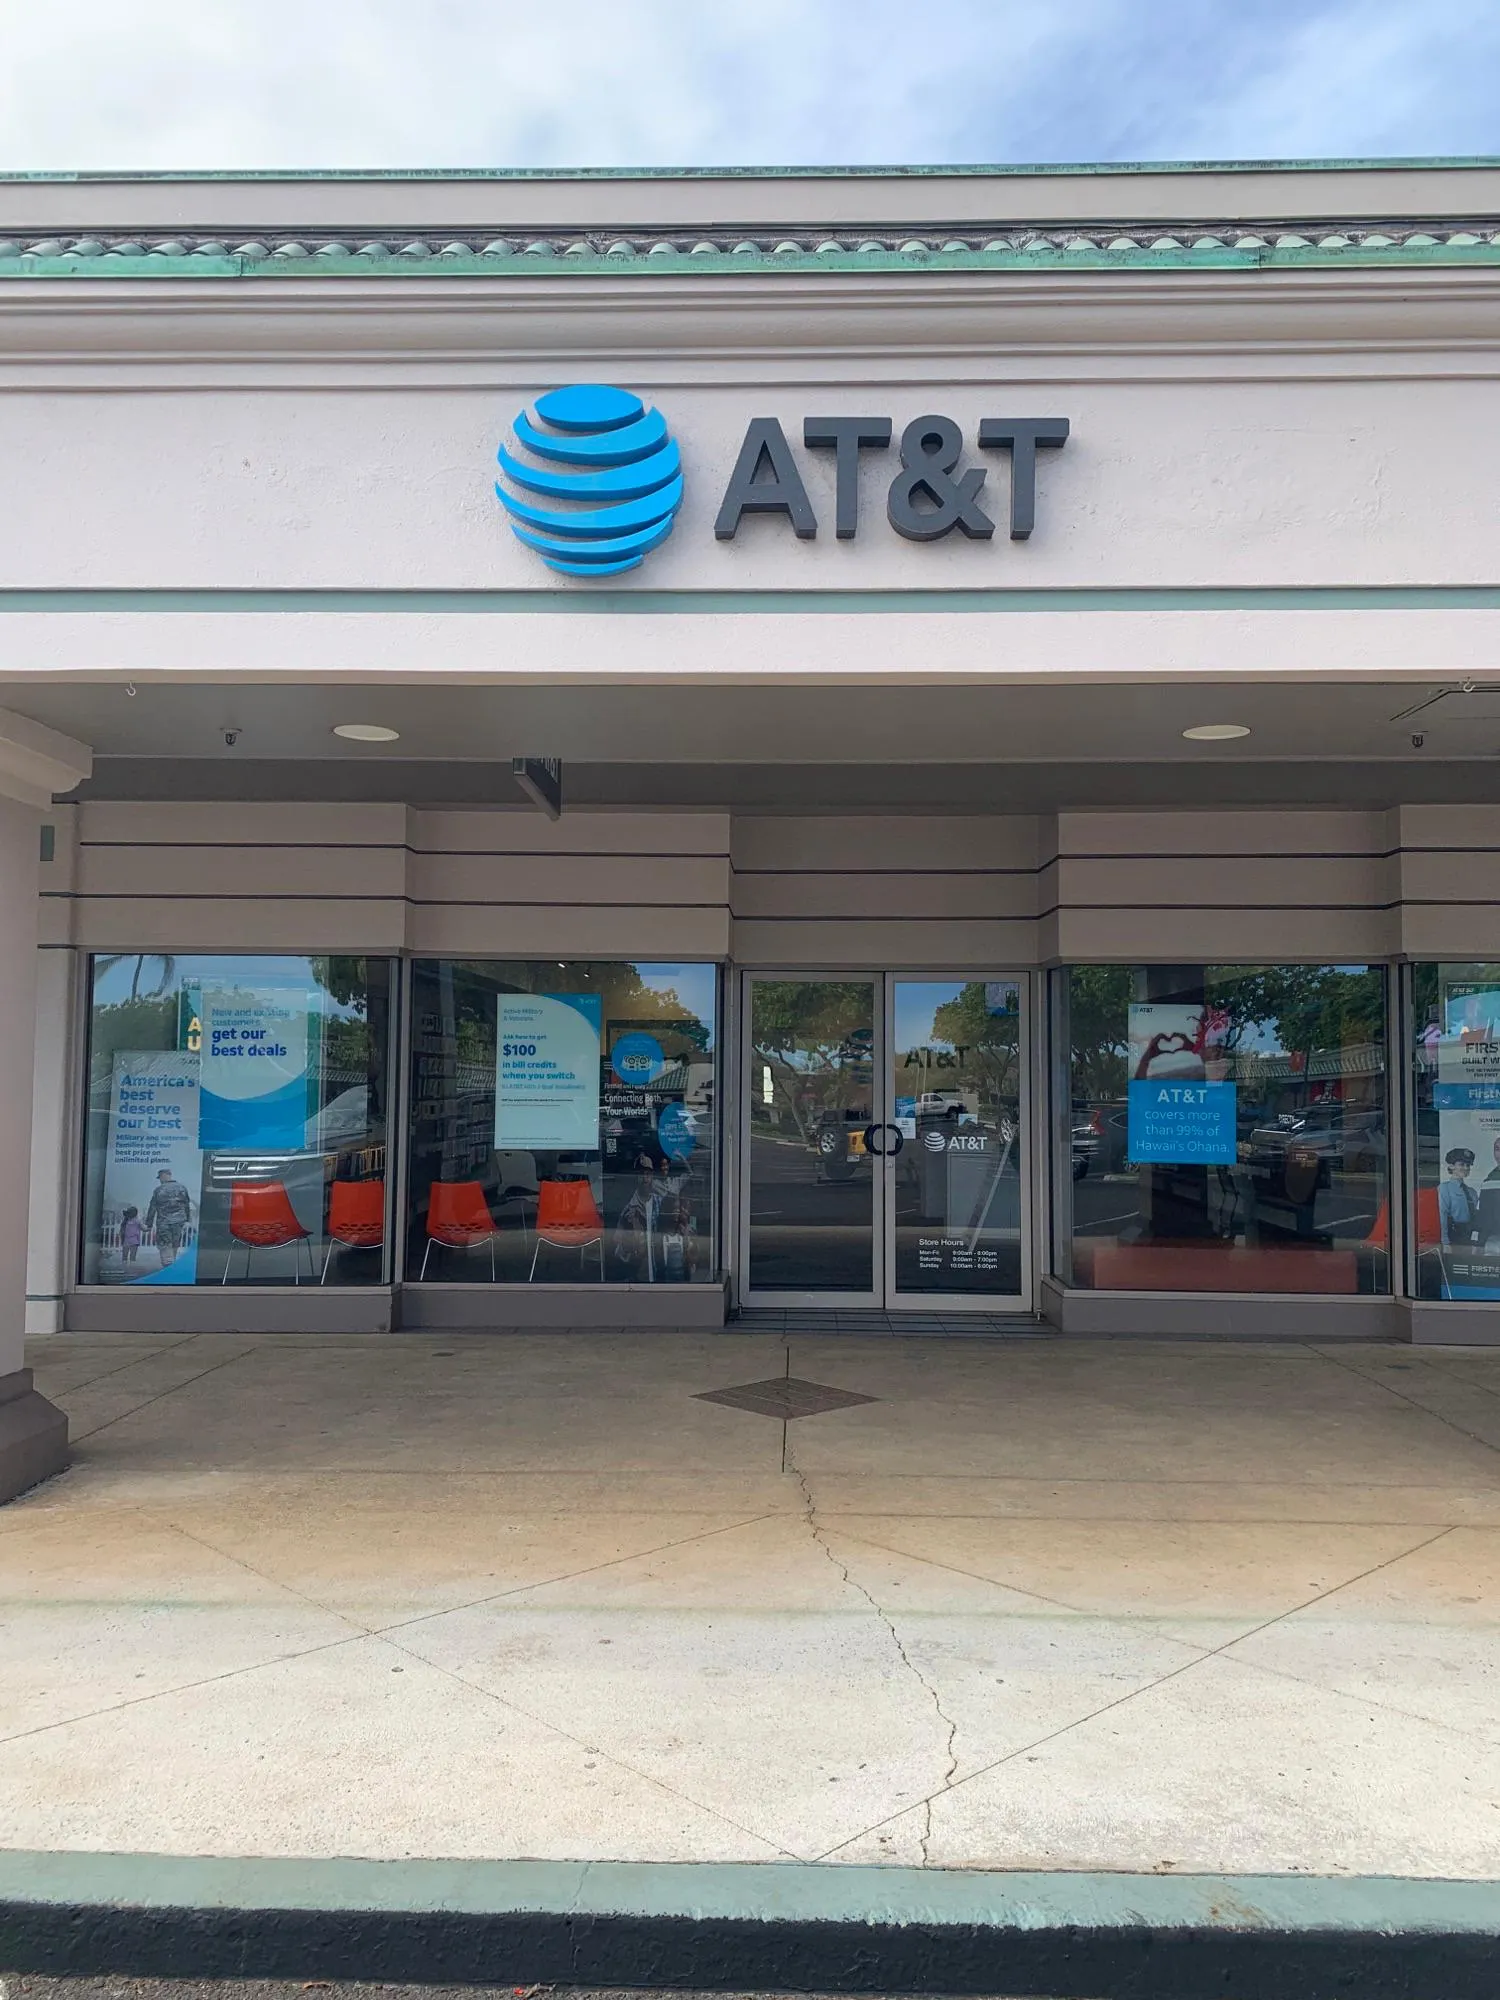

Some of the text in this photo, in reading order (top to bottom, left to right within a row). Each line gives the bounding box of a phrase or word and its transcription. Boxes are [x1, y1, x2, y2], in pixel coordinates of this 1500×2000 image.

[714, 414, 1069, 541] AT&T
[212, 1008, 232, 1017] New
[234, 1008, 251, 1017] and
[212, 1028, 266, 1043] get our
[211, 1043, 287, 1056] best deals
[503, 1043, 536, 1057] $100
[1466, 1042, 1500, 1054] FIRS
[904, 1046, 971, 1069] AT&T
[527, 1061, 557, 1069] credits
[120, 1074, 195, 1088] America's
[120, 1088, 154, 1101] best
[604, 1093, 644, 1104] Connecting
[1157, 1088, 1208, 1104] AT&T
[119, 1102, 181, 1115] deserve
[605, 1107, 623, 1116] Your
[1145, 1111, 1221, 1120] covers more
[118, 1116, 182, 1129] our best
[1145, 1124, 1221, 1136] than 99% of
[948, 1136, 988, 1150] AT&T
[1136, 1140, 1230, 1153] Hawaii's Ohana.
